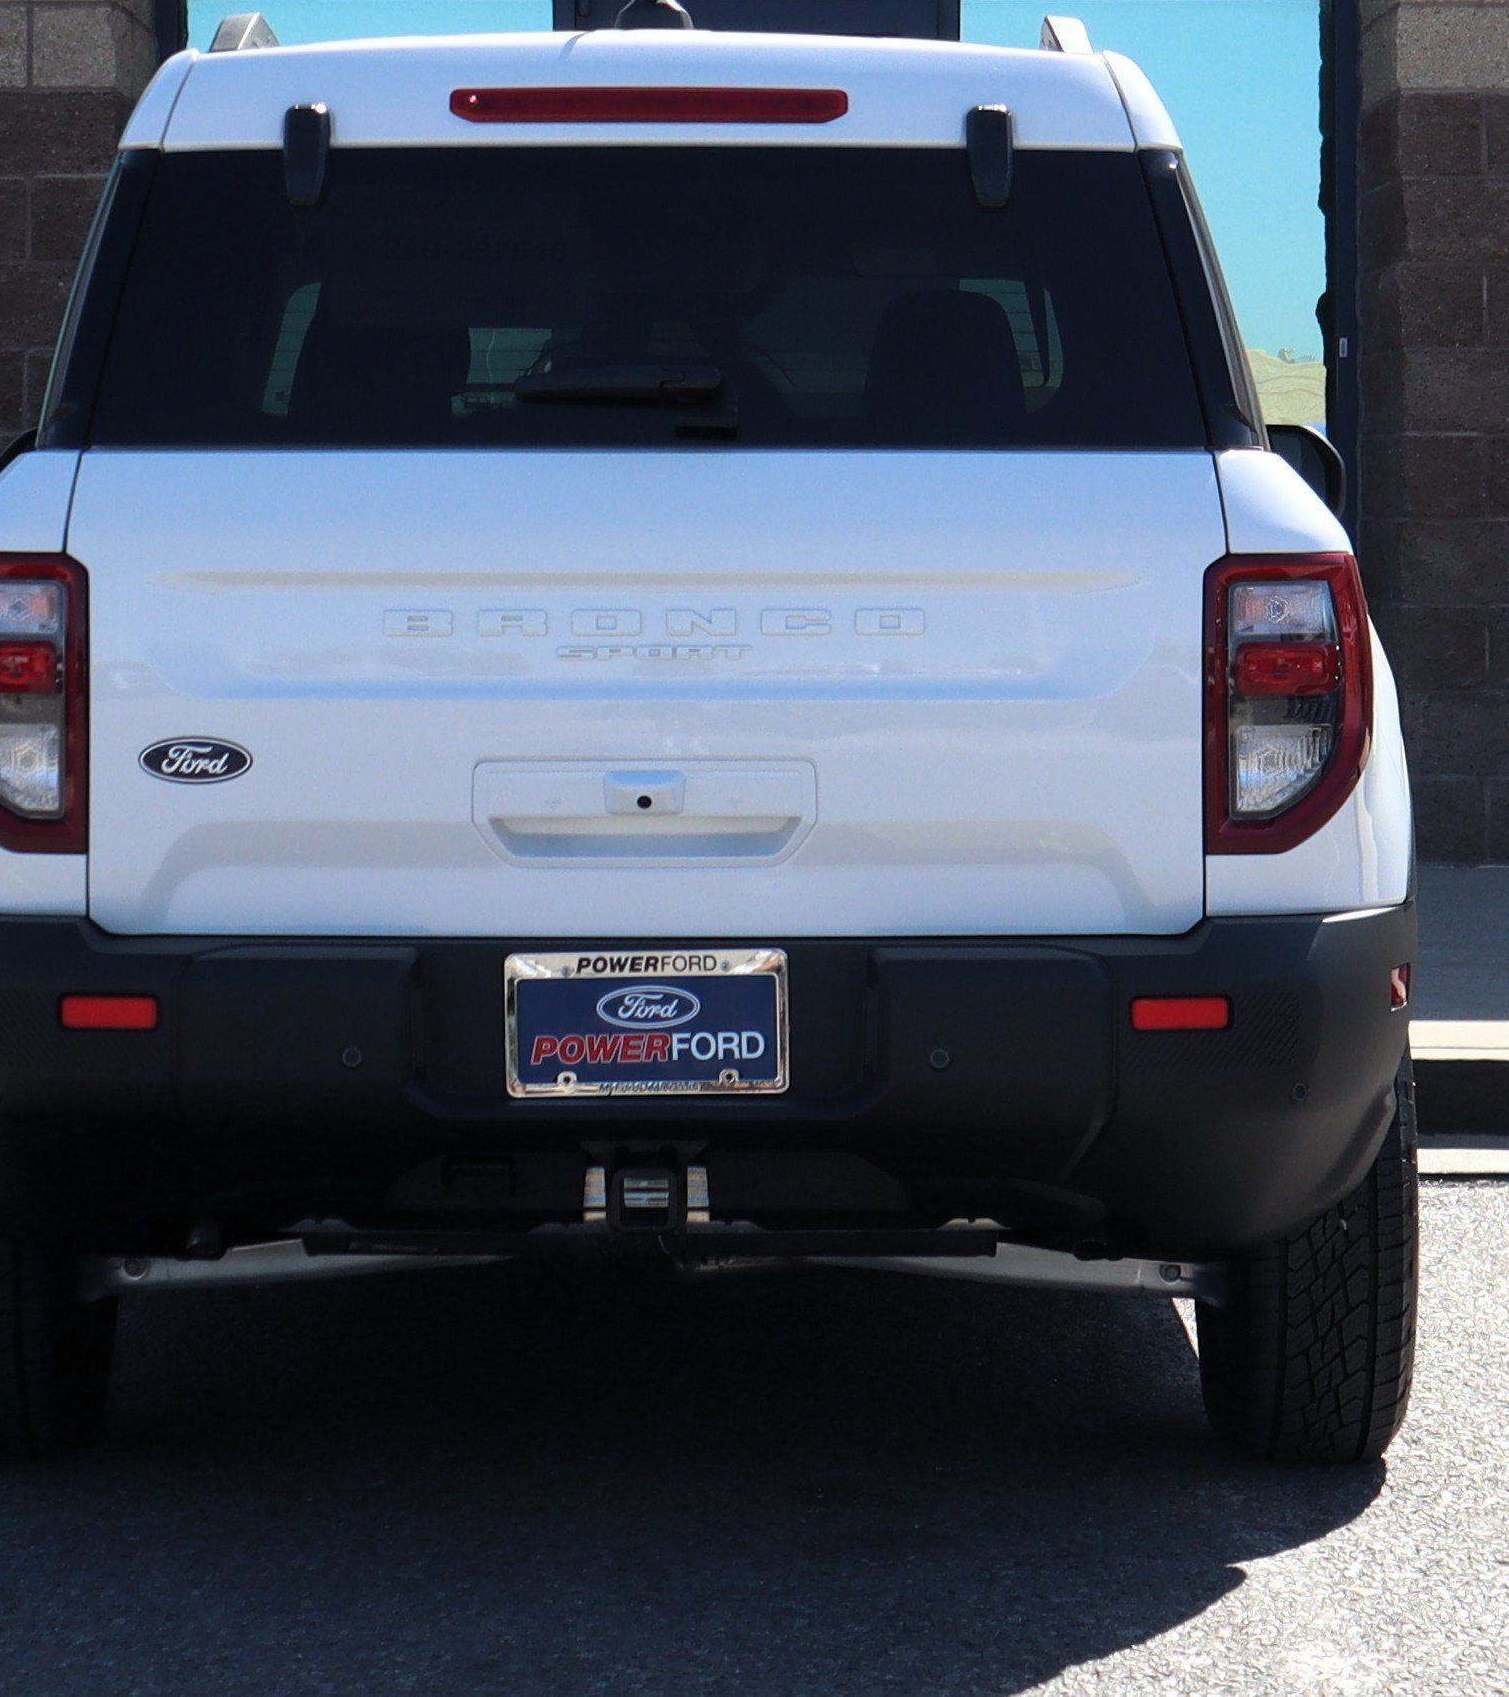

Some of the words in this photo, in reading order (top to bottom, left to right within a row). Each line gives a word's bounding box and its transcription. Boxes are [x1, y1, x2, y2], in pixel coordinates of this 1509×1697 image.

[383, 607, 926, 637] BRONCO
[556, 644, 754, 662] SPORT
[161, 744, 230, 774] Ford
[576, 955, 717, 975] POWERFORD
[617, 994, 679, 1019] Ford
[530, 1031, 765, 1066] POWERFORD
